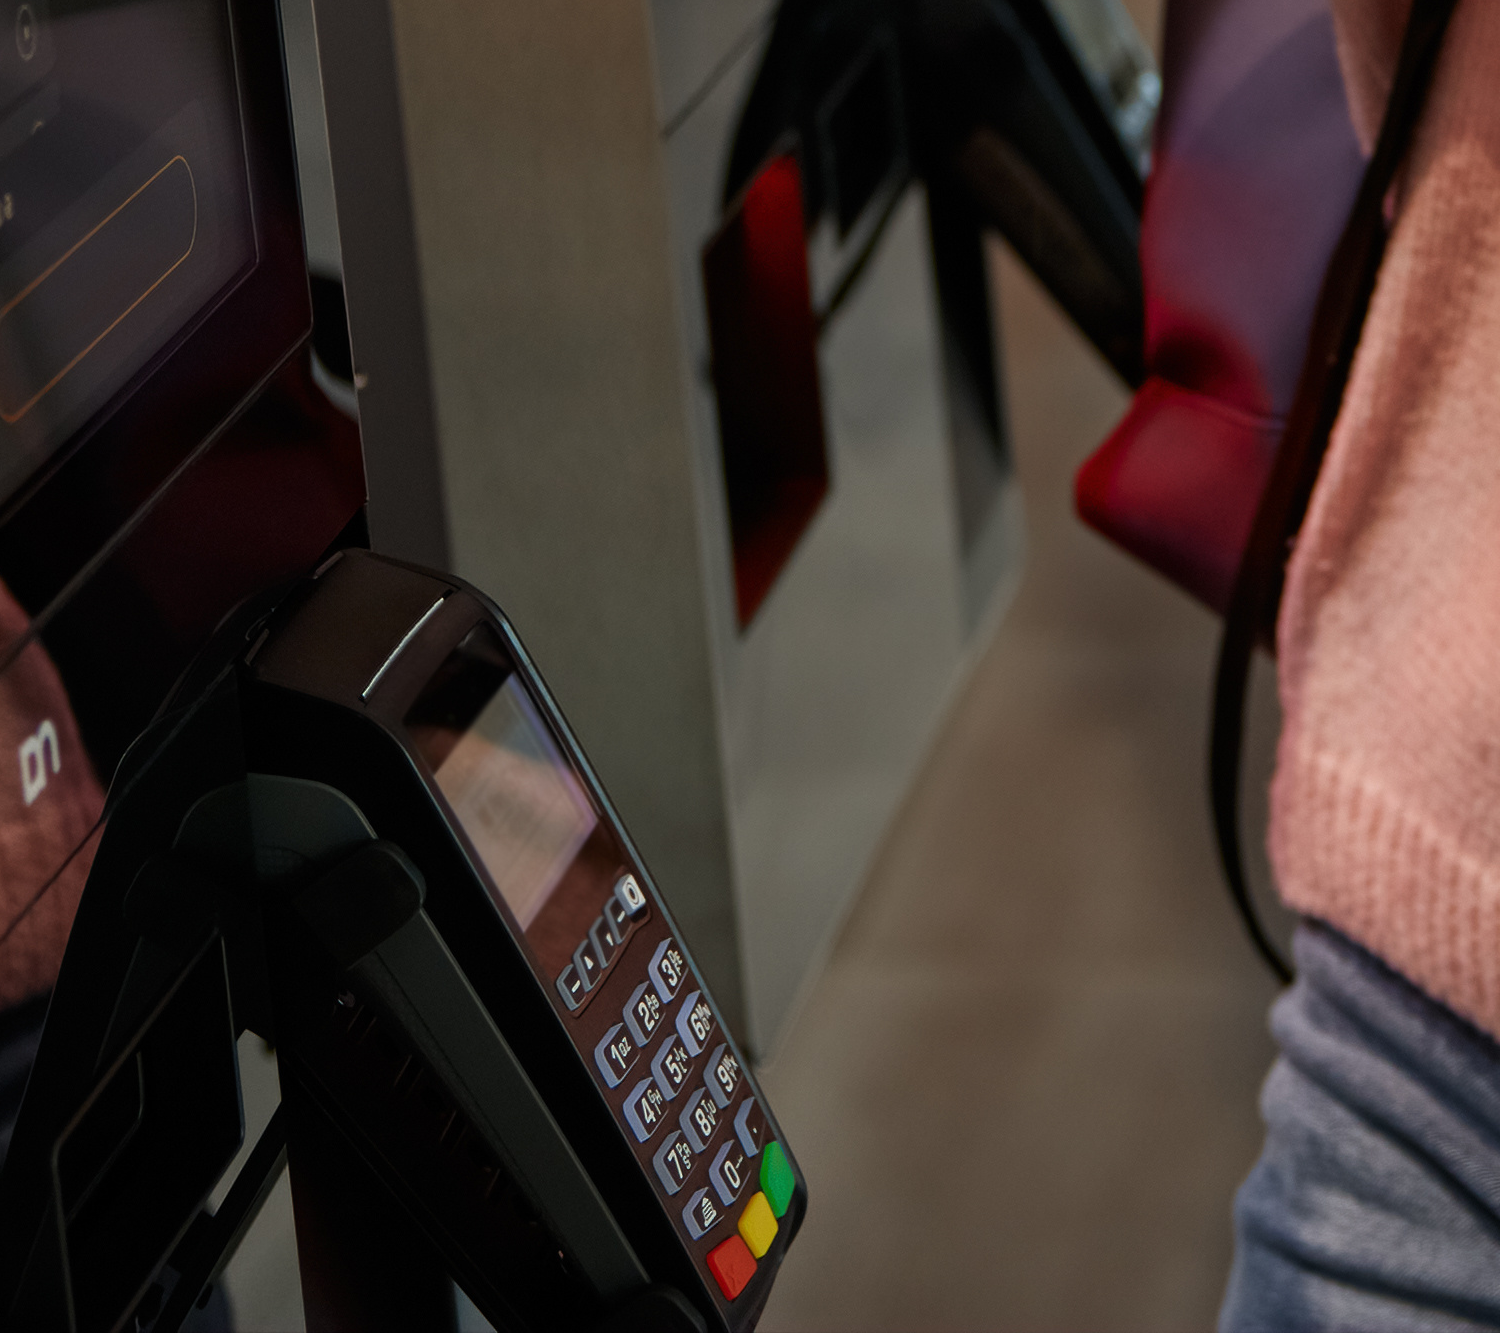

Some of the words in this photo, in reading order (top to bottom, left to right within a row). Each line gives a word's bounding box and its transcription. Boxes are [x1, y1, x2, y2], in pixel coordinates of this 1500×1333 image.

[661, 958, 678, 986] 3
[638, 1002, 655, 1031] 2
[690, 1012, 706, 1041] 6
[611, 1044, 626, 1069] 1
[665, 1054, 682, 1083] 5
[717, 1064, 734, 1092] 9
[641, 1097, 656, 1124] 4
[695, 1107, 712, 1137] 8
[667, 1148, 683, 1179] 7
[724, 1160, 740, 1189] 0
